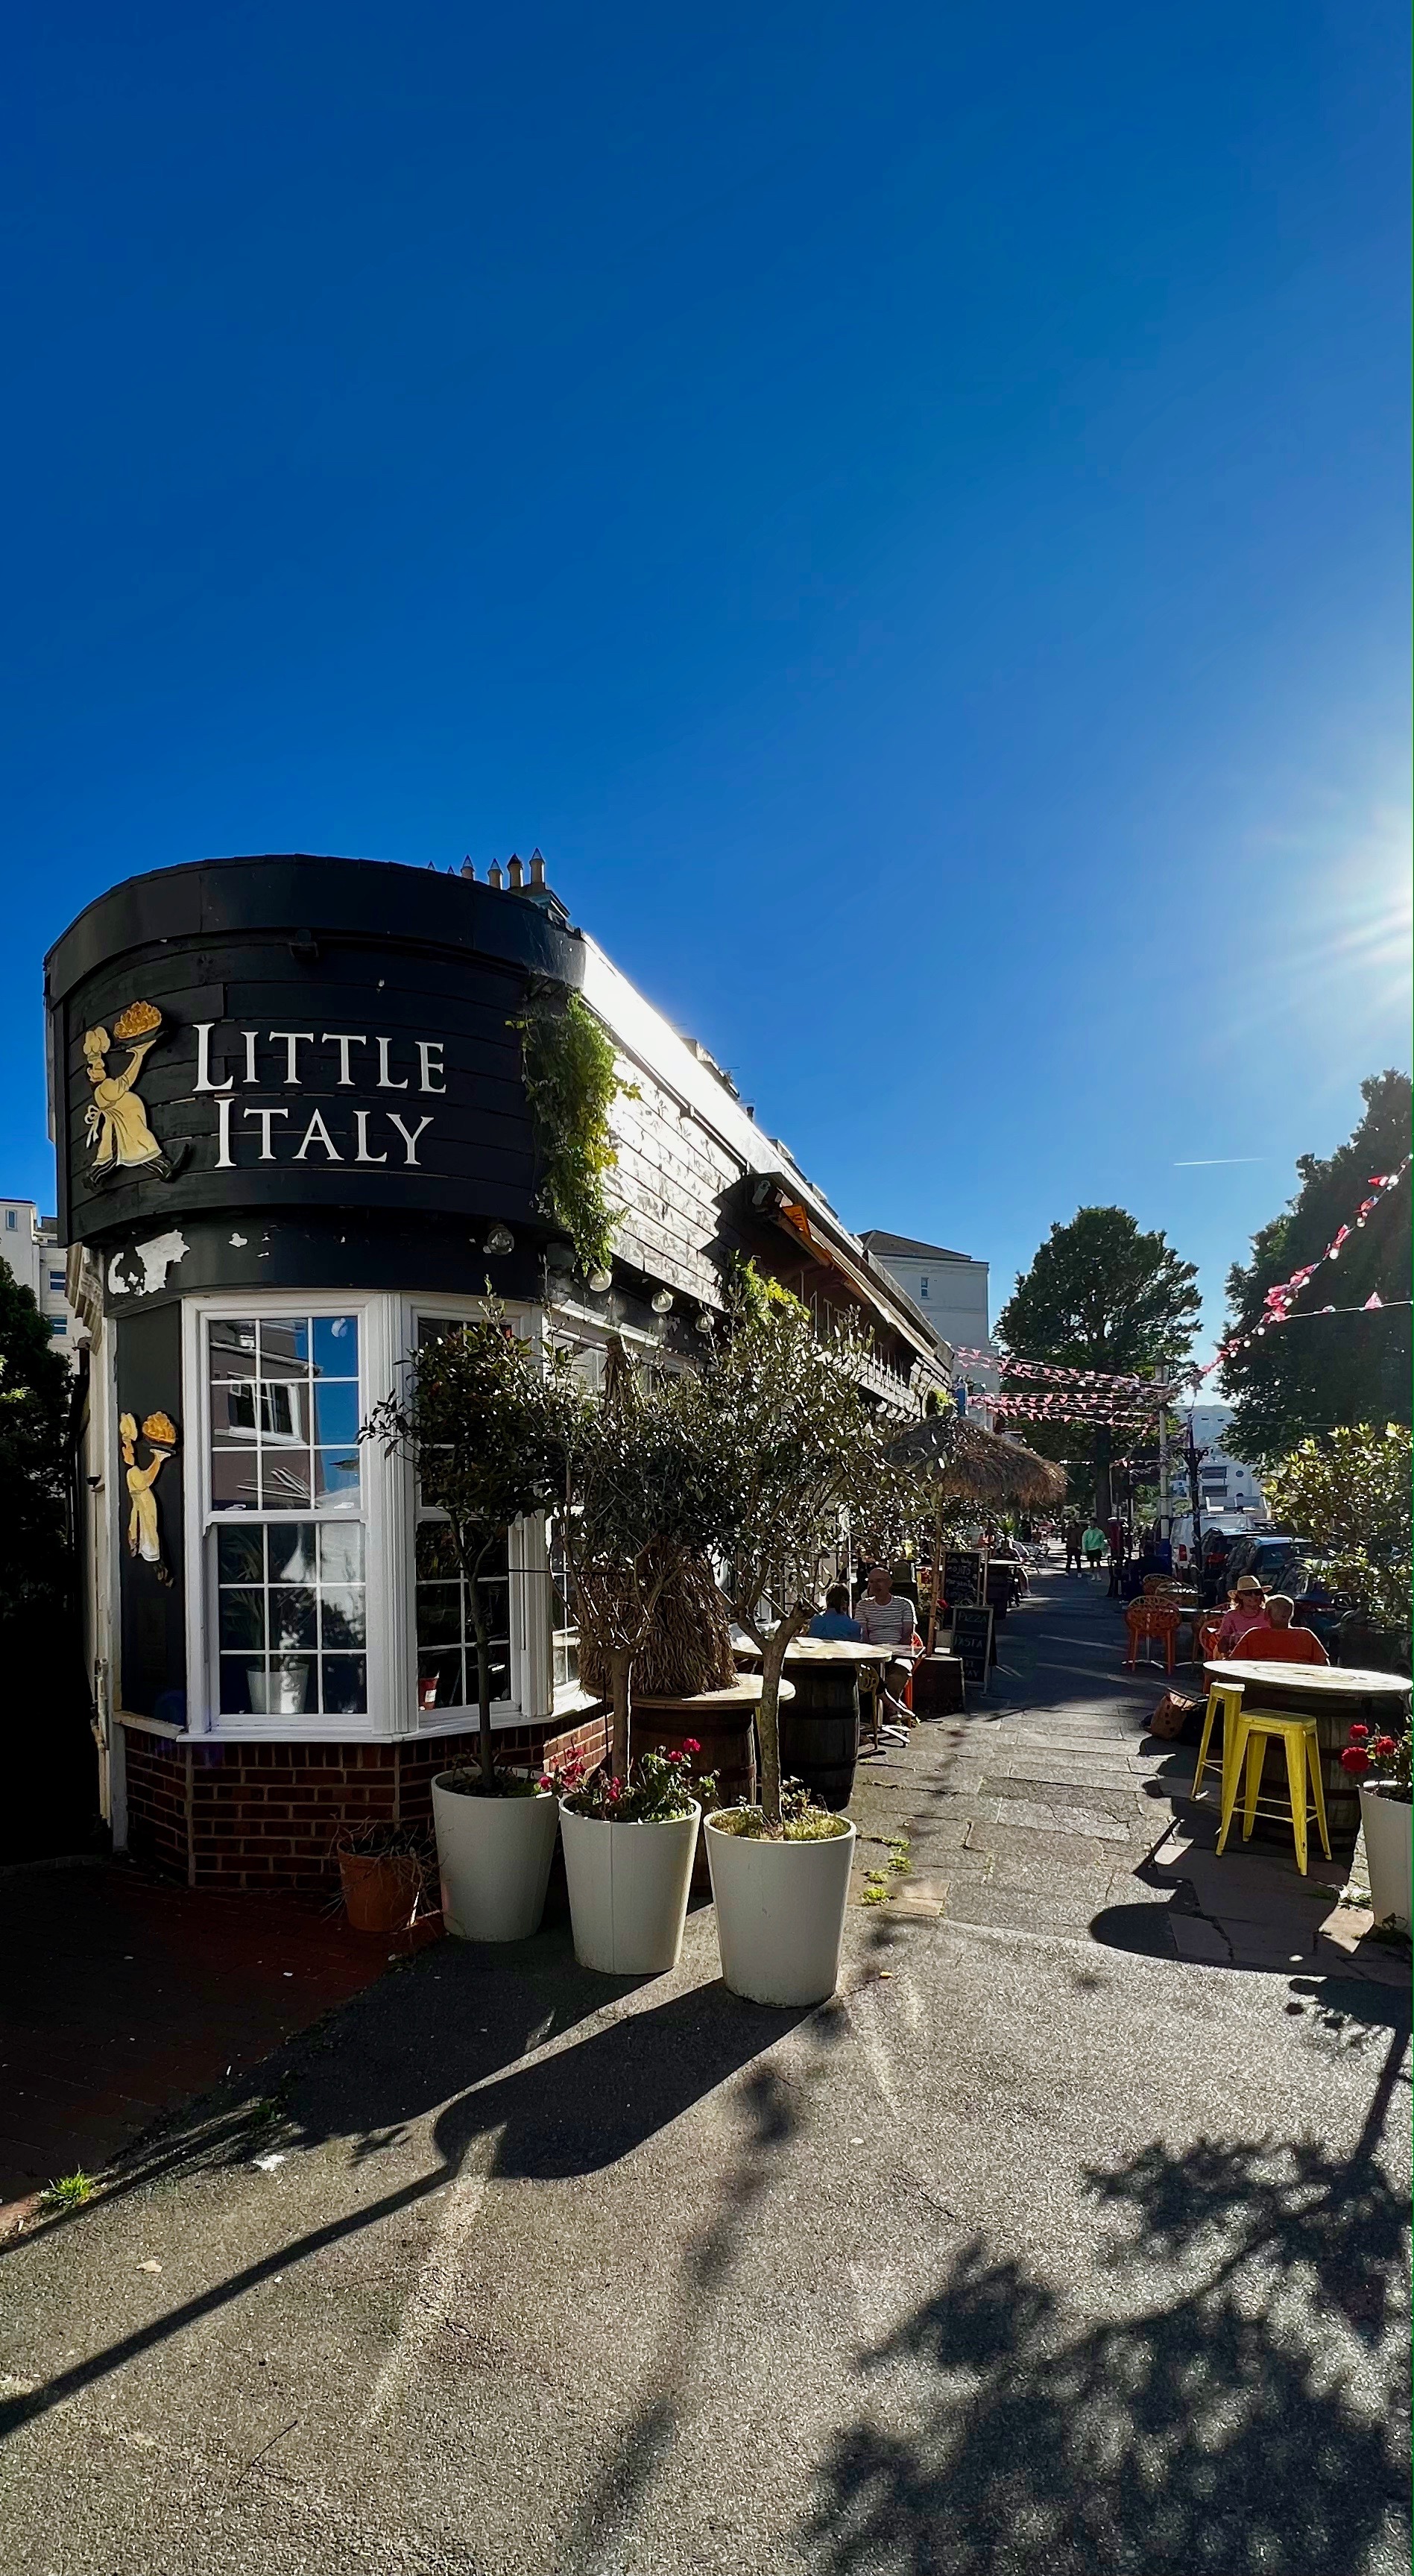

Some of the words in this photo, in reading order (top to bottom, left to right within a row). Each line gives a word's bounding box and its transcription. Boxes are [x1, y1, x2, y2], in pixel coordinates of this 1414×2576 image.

[192, 1023, 446, 1093] LITTLE
[213, 1098, 435, 1168] ITALY
[954, 1634, 983, 1648] PASTA
